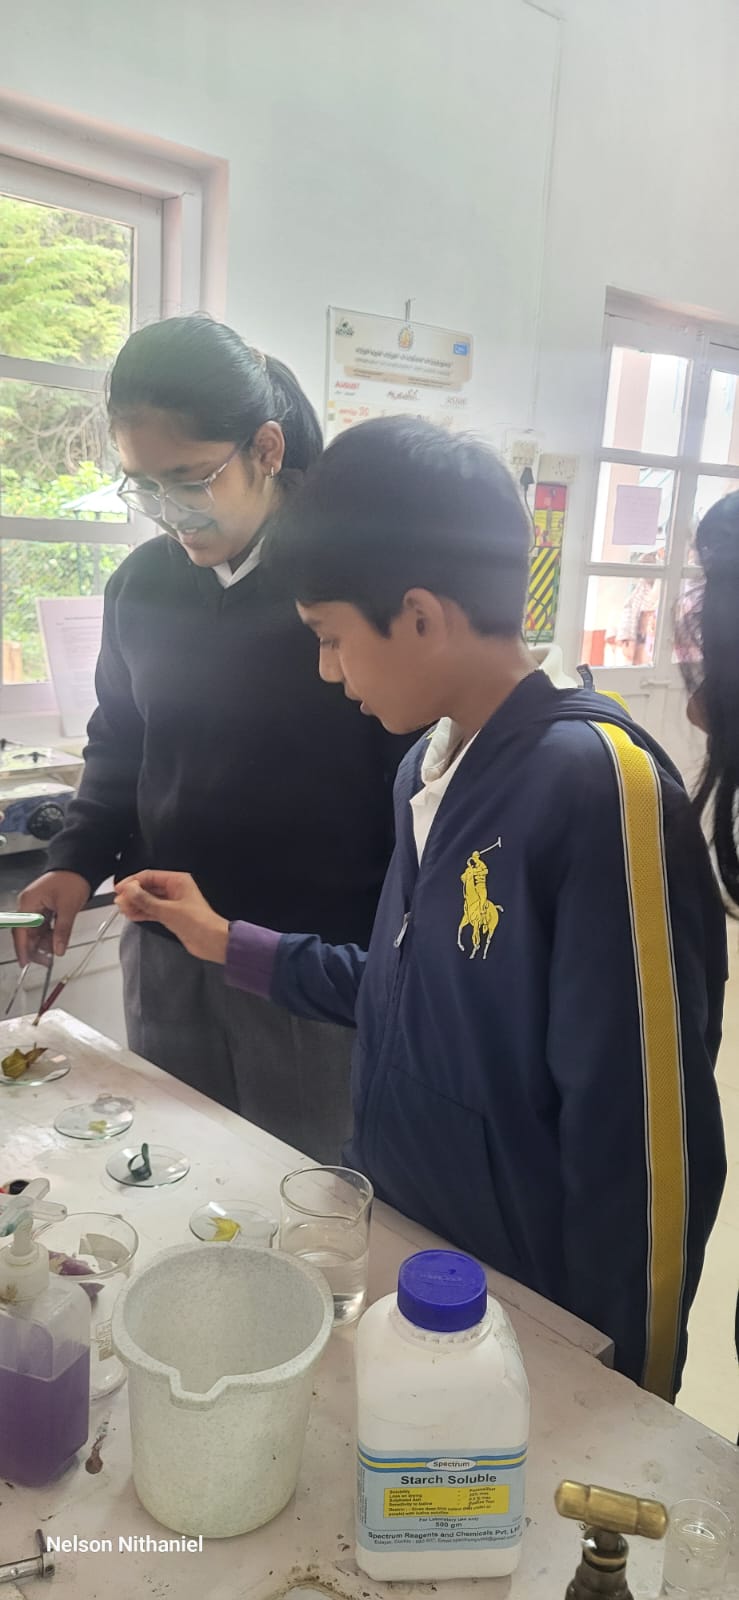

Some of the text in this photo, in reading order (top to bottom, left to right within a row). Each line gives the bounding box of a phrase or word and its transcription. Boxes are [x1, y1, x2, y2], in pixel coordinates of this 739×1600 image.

[401, 1473, 497, 1485] Starch Soluble
[368, 1532, 403, 1540] Spectrum
